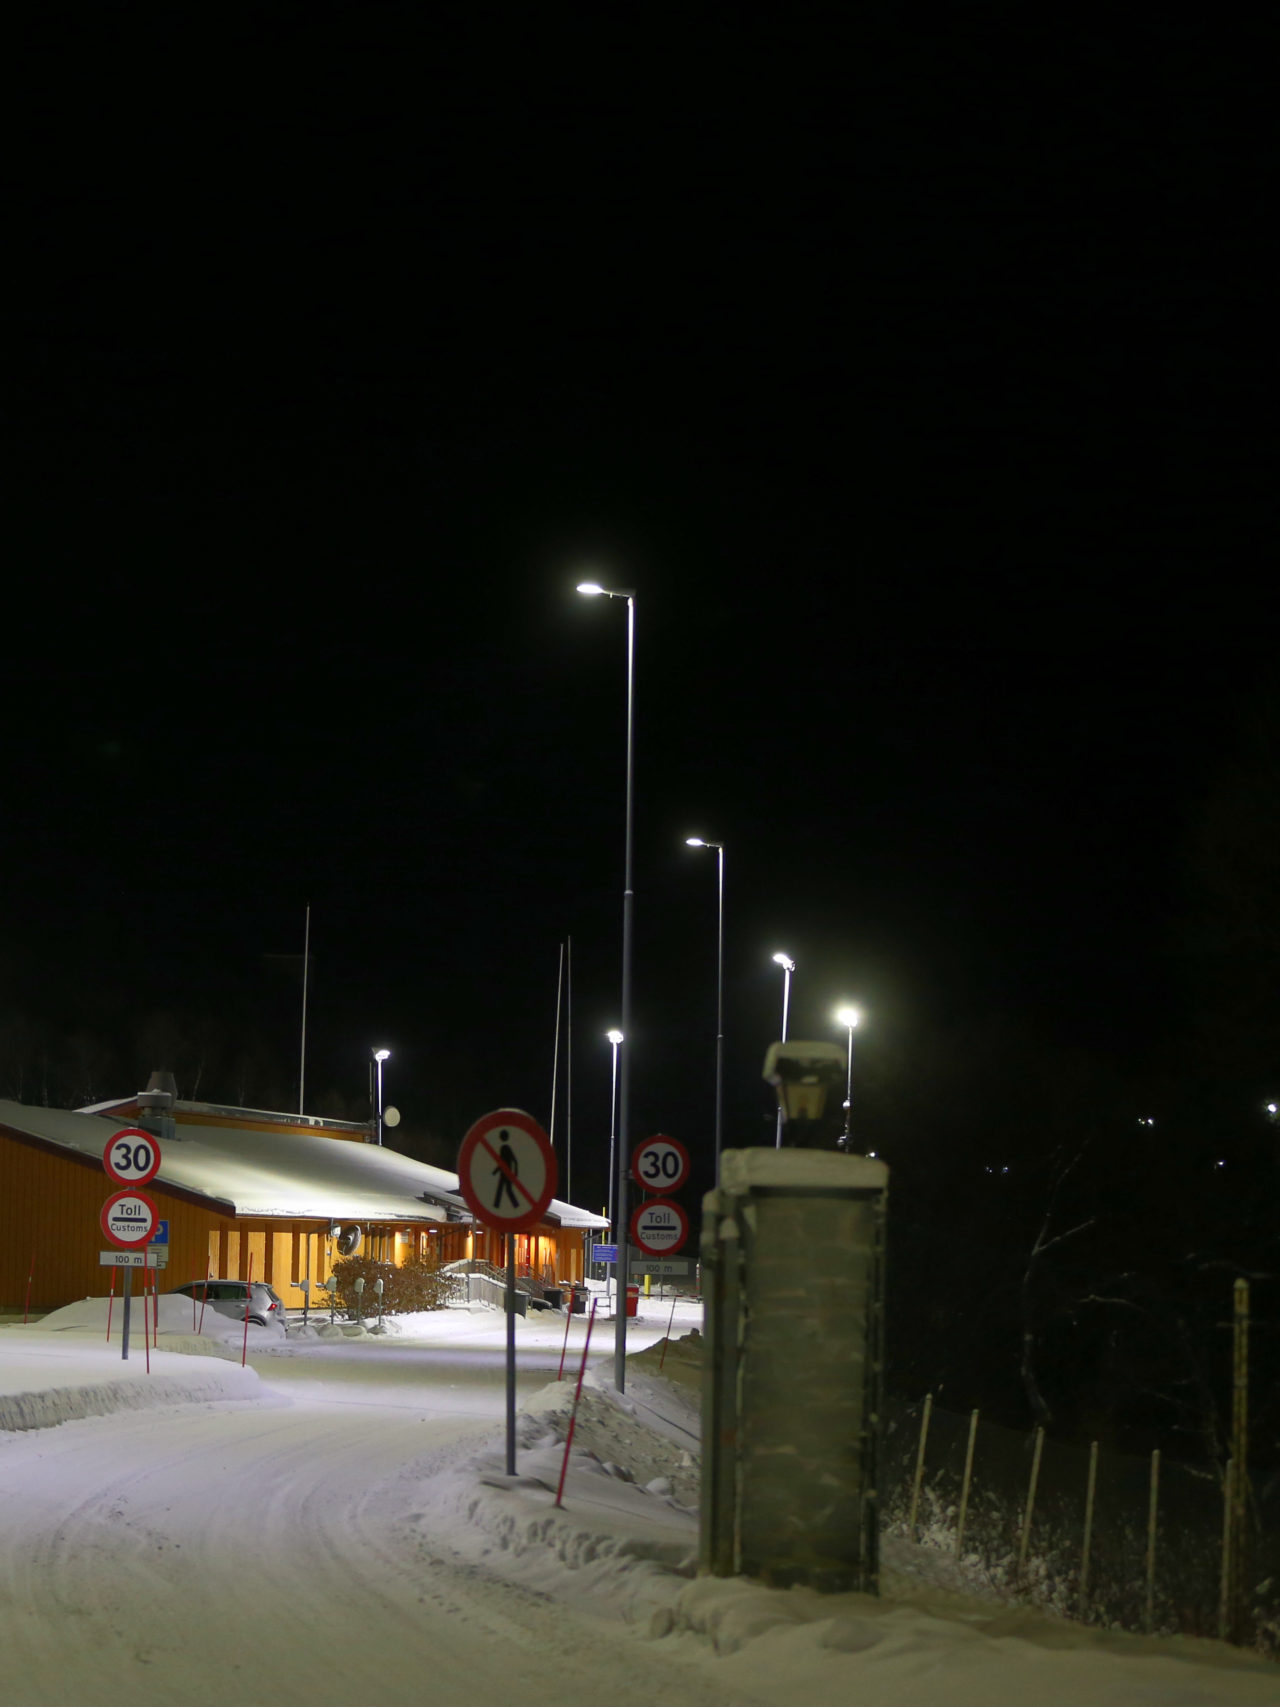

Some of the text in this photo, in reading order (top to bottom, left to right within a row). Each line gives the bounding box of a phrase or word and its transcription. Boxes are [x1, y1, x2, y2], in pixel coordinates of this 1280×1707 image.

[114, 1143, 151, 1172] 30
[643, 1150, 680, 1179] 30
[118, 1204, 141, 1216] Toll
[647, 1212, 671, 1225] Toll
[111, 1223, 148, 1232] Customs
[640, 1232, 678, 1241] Customs
[115, 1255, 143, 1264] 100 m
